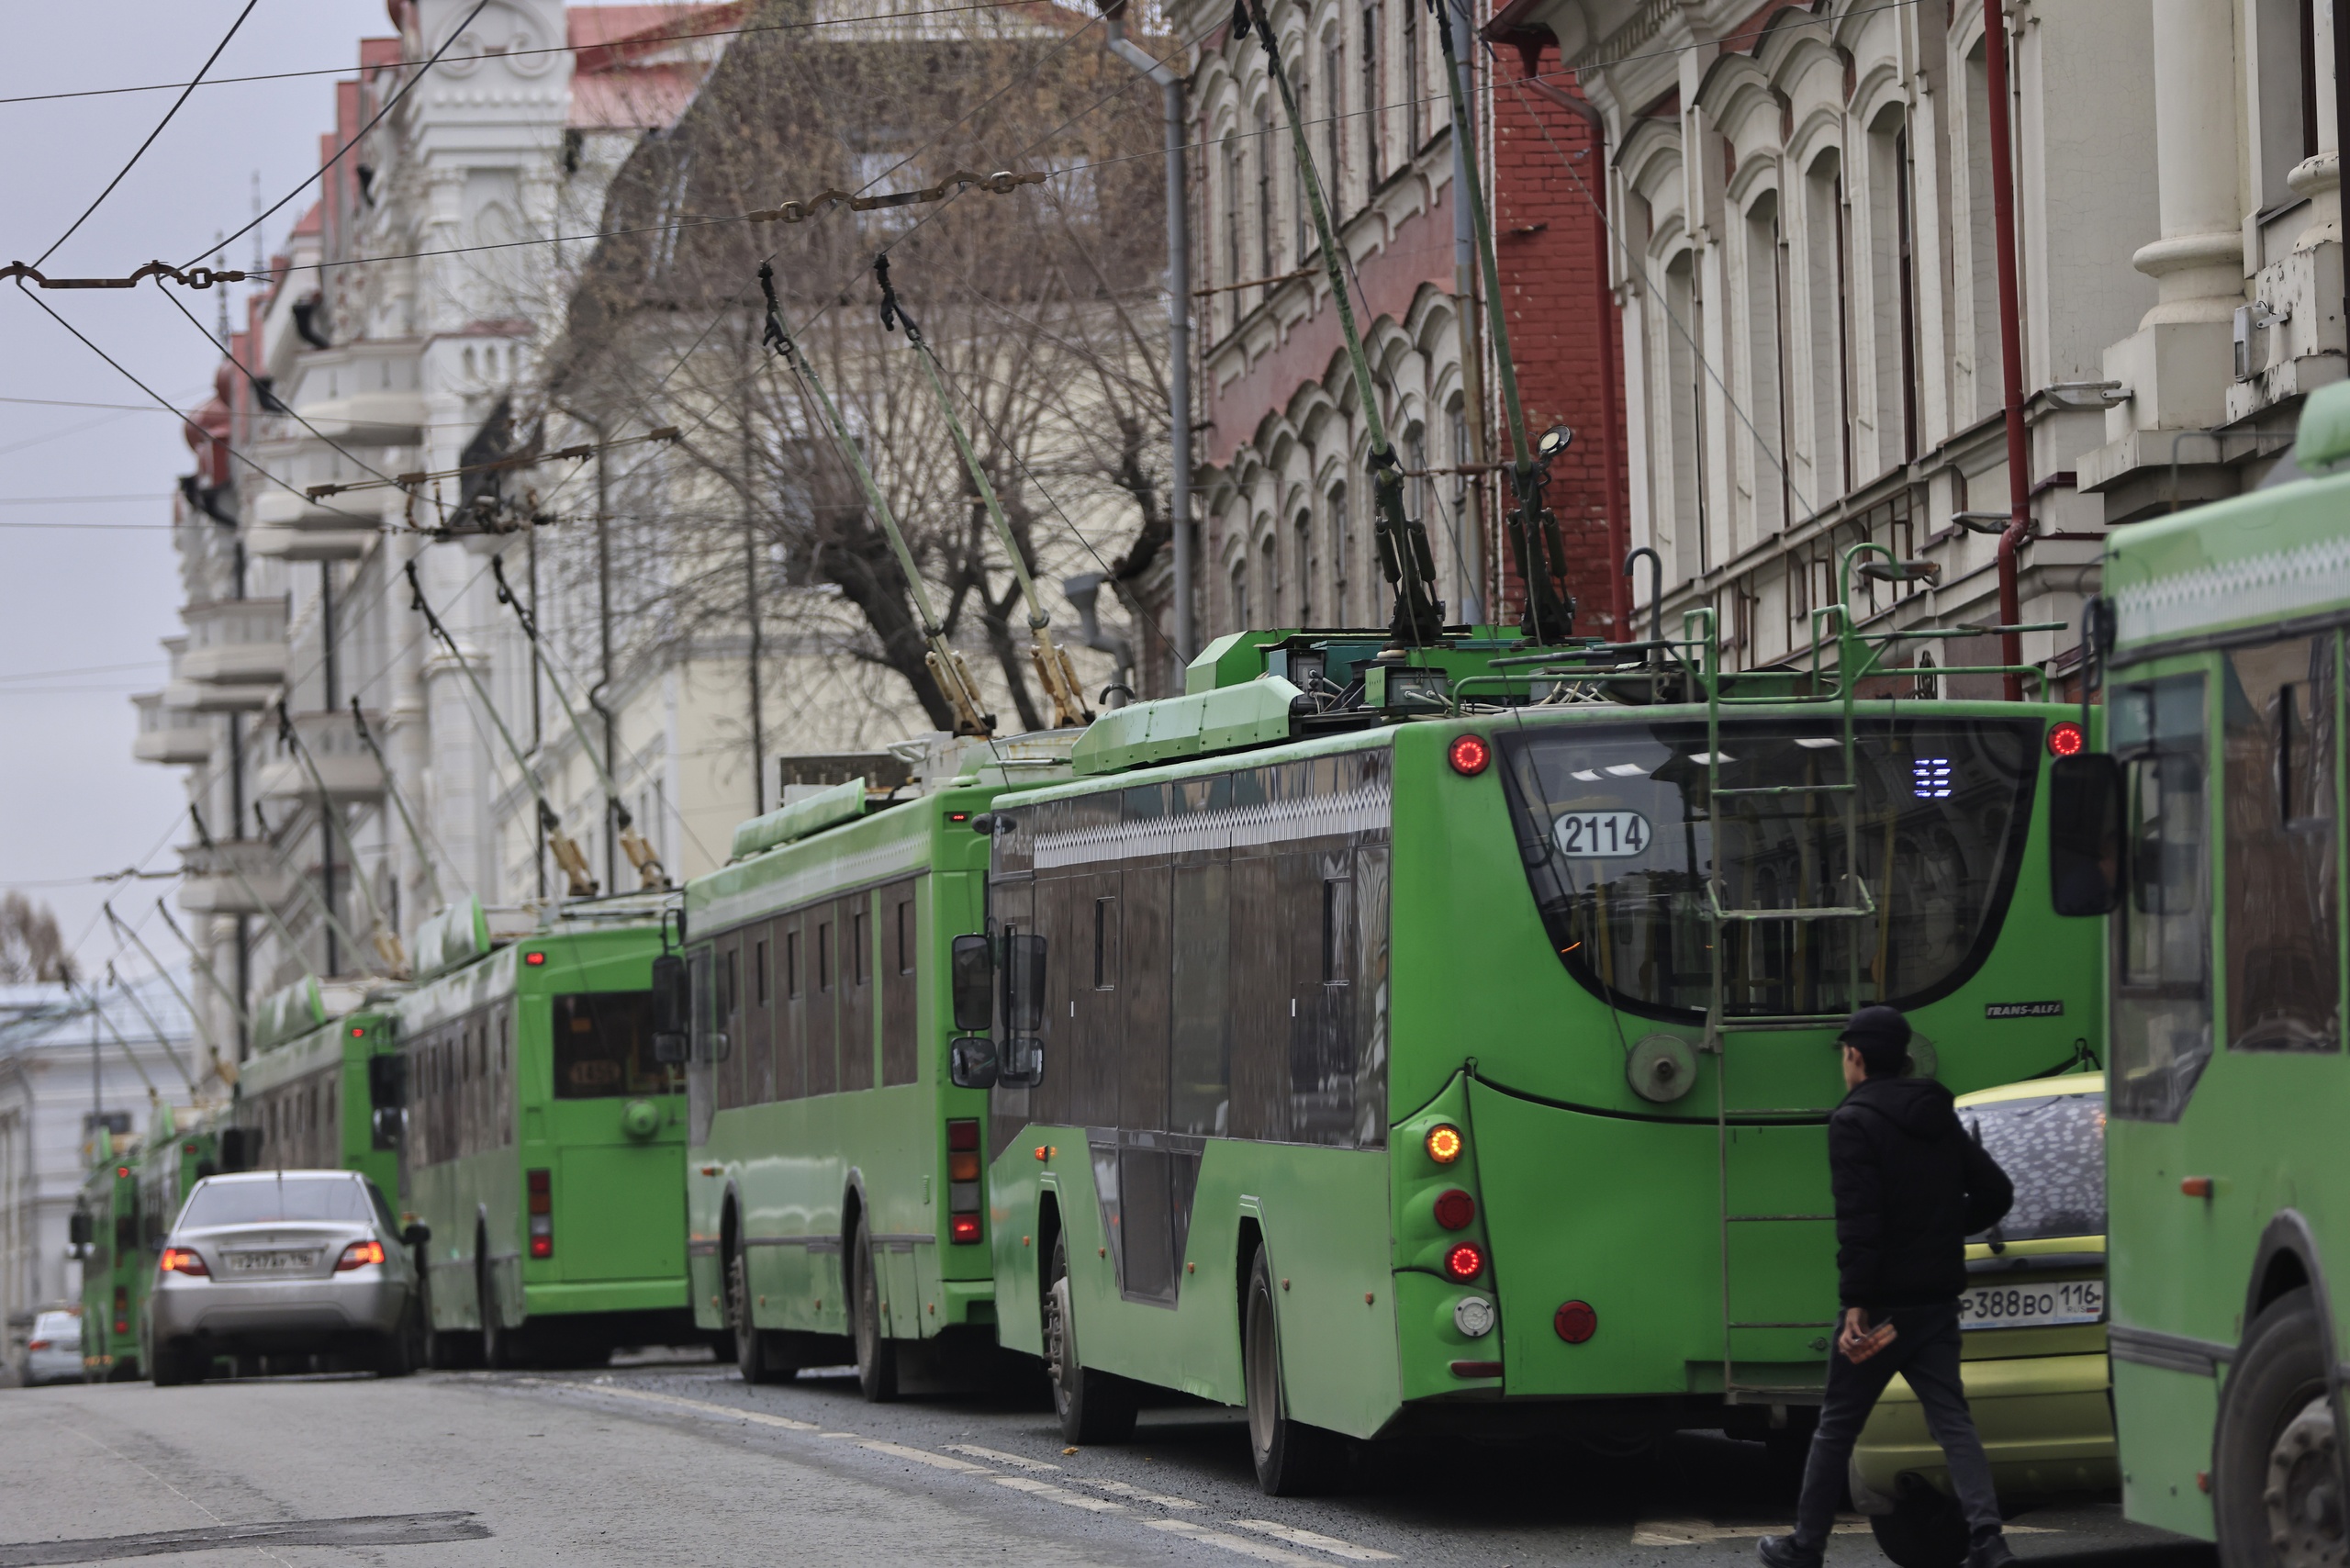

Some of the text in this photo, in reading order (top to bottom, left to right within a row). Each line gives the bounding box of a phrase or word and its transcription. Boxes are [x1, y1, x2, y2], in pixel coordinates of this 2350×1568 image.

[1565, 815, 1643, 853] 2114
[2060, 1283, 2095, 1305] 116
[2065, 1305, 2087, 1314] RUS
